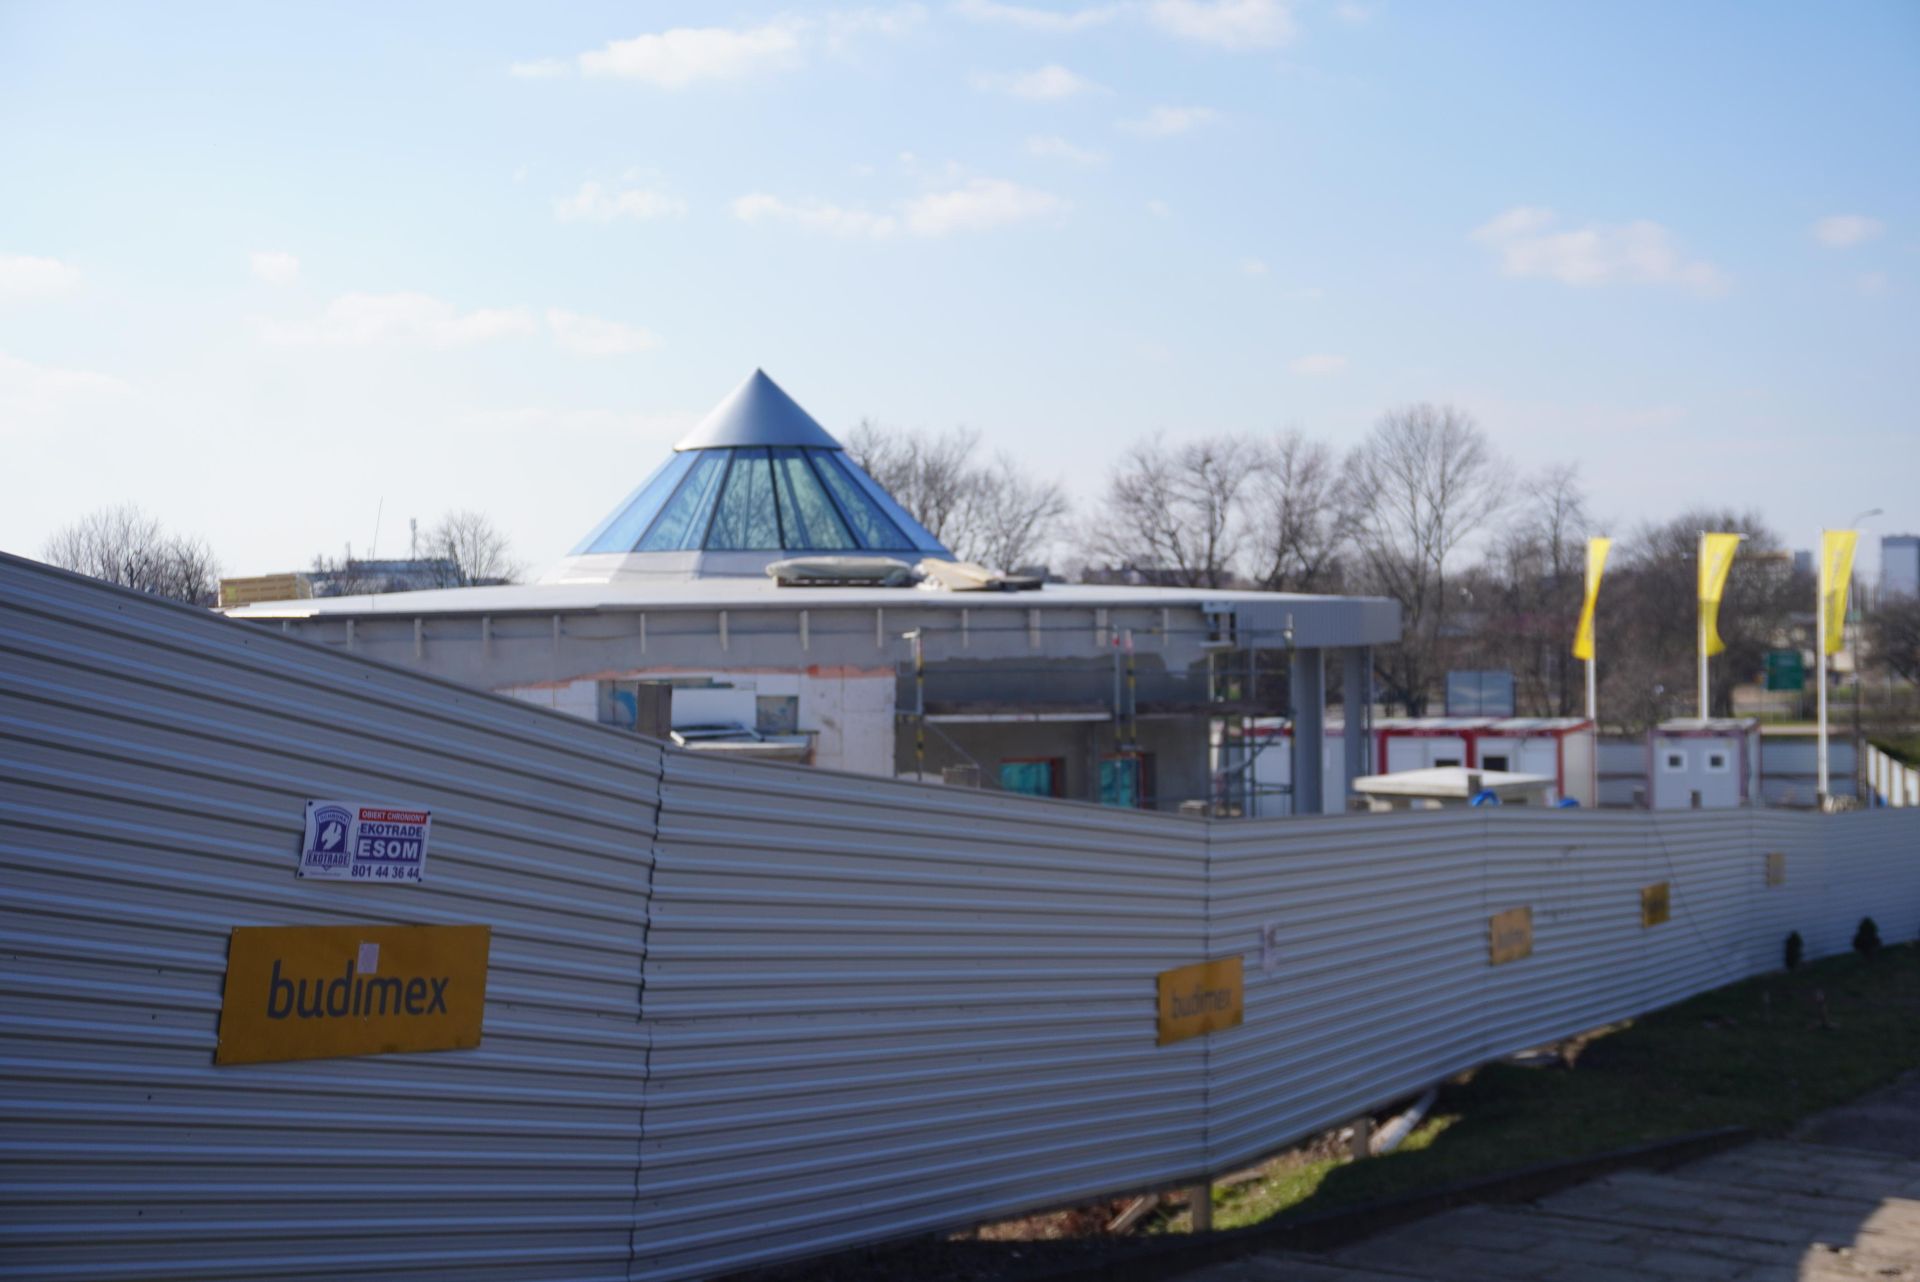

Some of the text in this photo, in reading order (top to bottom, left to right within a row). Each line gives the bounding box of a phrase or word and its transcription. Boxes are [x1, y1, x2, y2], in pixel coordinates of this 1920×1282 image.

[362, 810, 425, 823] OBIEKT CHRONIONY
[360, 823, 423, 837] EKOTRADE
[357, 839, 419, 859] ESOM
[307, 852, 350, 865] EKOTRADE
[351, 865, 420, 879] 801 44 36 44
[266, 959, 449, 1019] budimex
